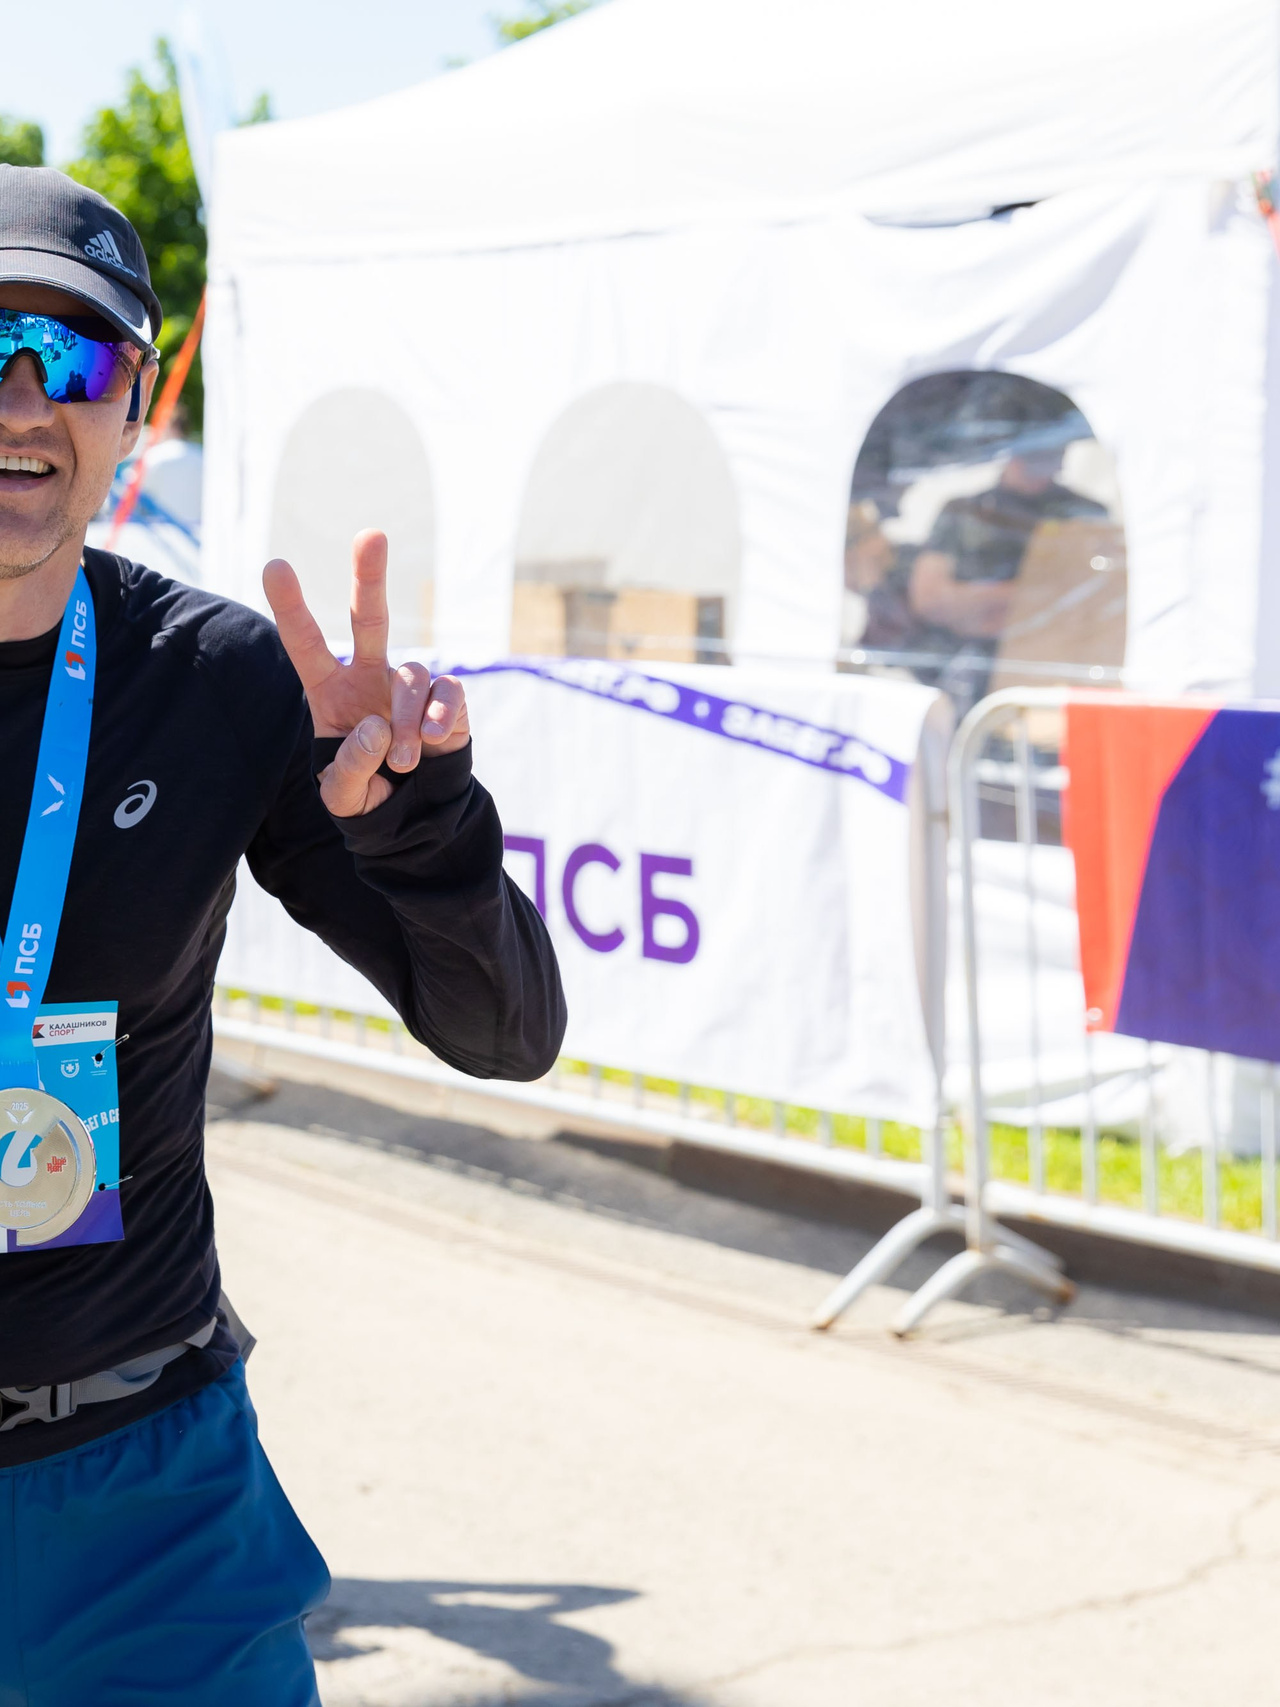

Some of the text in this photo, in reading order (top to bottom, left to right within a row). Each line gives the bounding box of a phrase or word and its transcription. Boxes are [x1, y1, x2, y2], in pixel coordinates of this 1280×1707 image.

[71, 600, 87, 649] ПСБ
[14, 923, 42, 975] ПСБ
[49, 1020, 107, 1030] КАЛАШНИКОВ
[49, 1029, 75, 1037] СПОРТ
[12, 1102, 29, 1111] 2025
[100, 1111, 109, 1126] В
